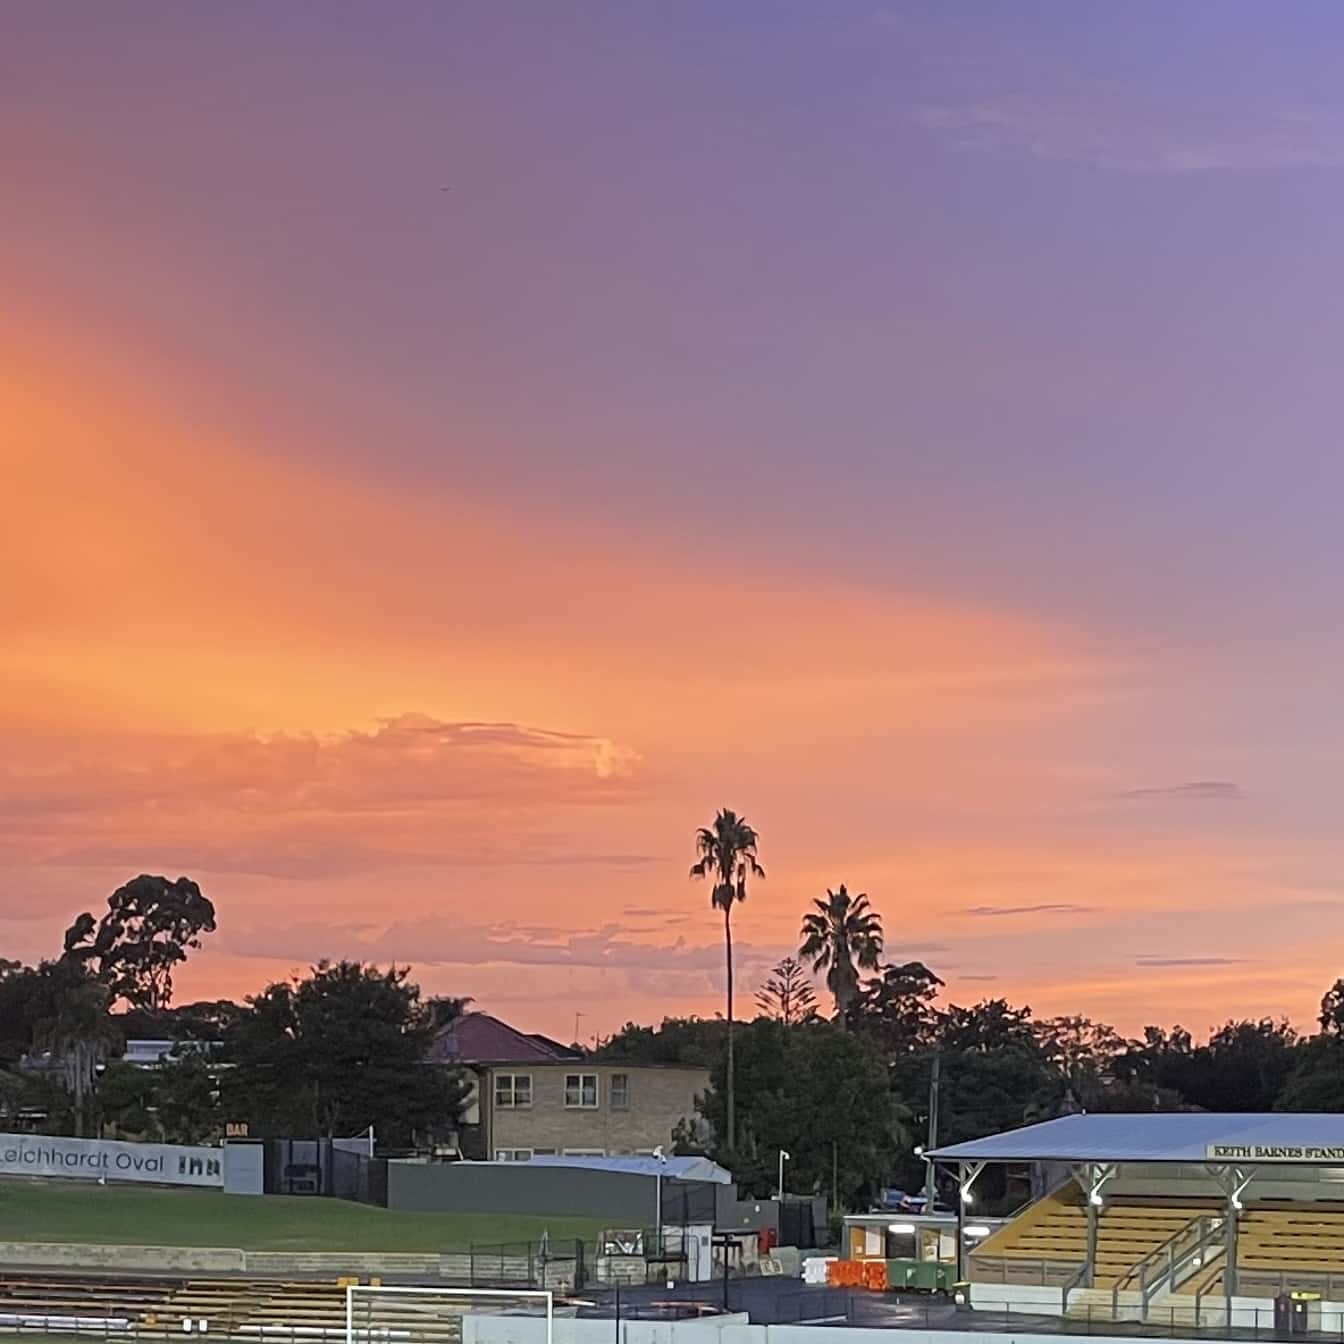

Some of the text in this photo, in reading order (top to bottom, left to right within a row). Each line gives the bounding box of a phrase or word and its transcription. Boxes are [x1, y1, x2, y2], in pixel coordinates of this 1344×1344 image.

[226, 1123, 248, 1137] BAR
[1215, 1146, 1251, 1157] KEITH
[1255, 1147, 1302, 1158] BARNES
[115, 1152, 164, 1172] Oval
